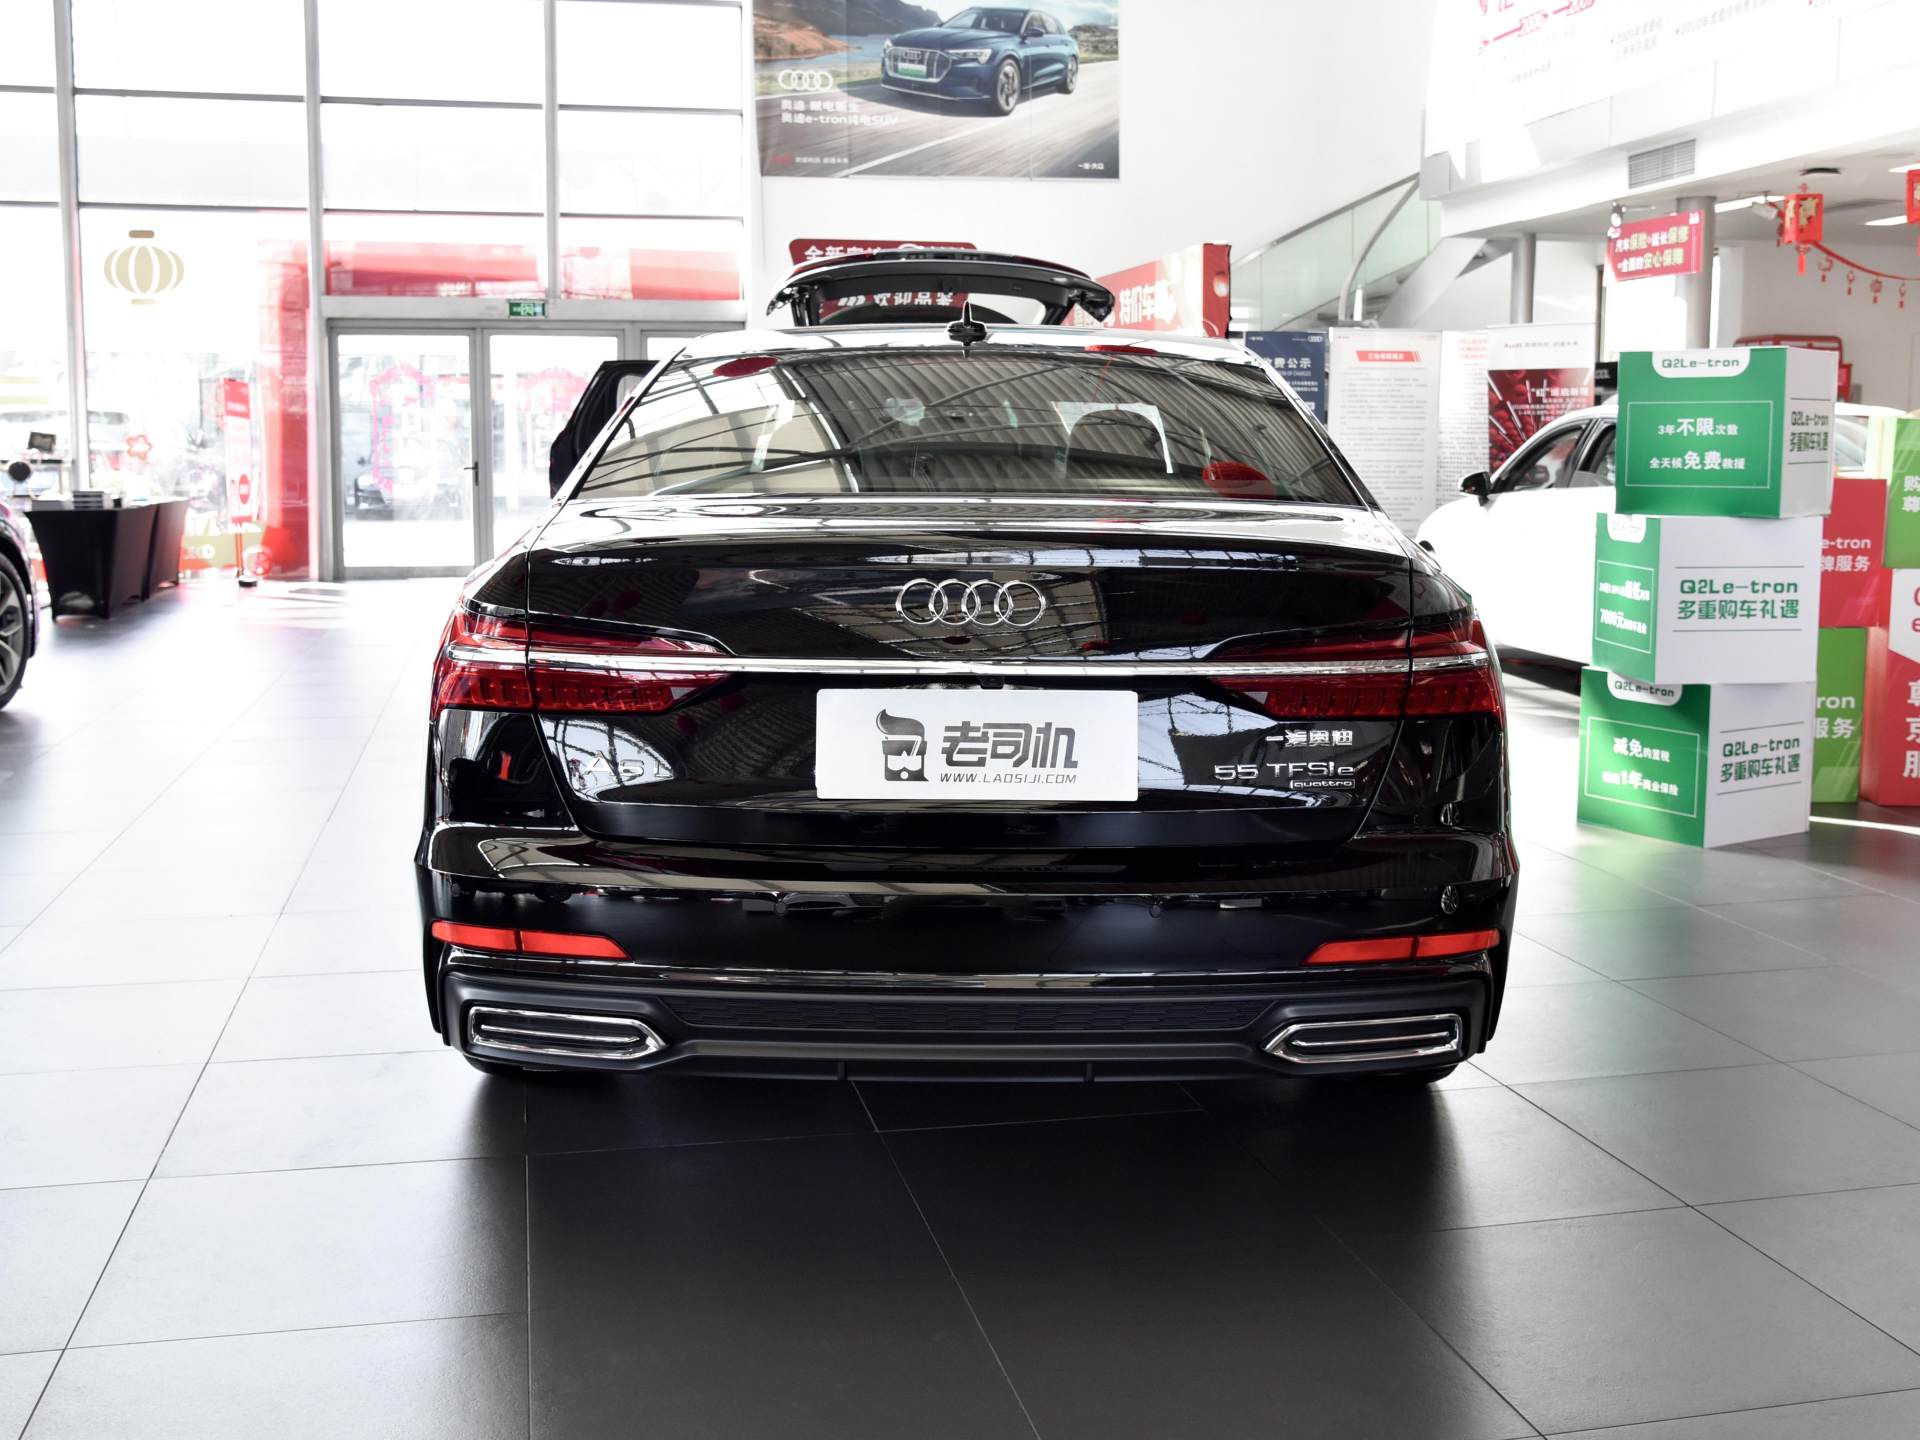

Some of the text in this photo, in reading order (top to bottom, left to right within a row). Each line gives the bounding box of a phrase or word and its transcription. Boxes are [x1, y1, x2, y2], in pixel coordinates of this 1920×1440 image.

[1658, 417, 1738, 436] 3年不限次数
[1677, 599, 1800, 620] 多重购车礼遇
[941, 721, 1079, 768] 老司机
[1214, 763, 1259, 781] 55
[1720, 753, 1801, 783] 多重购车礼遇
[939, 772, 1077, 784] WWW.LAOSIJI.COM
[1292, 779, 1354, 789] quattro
